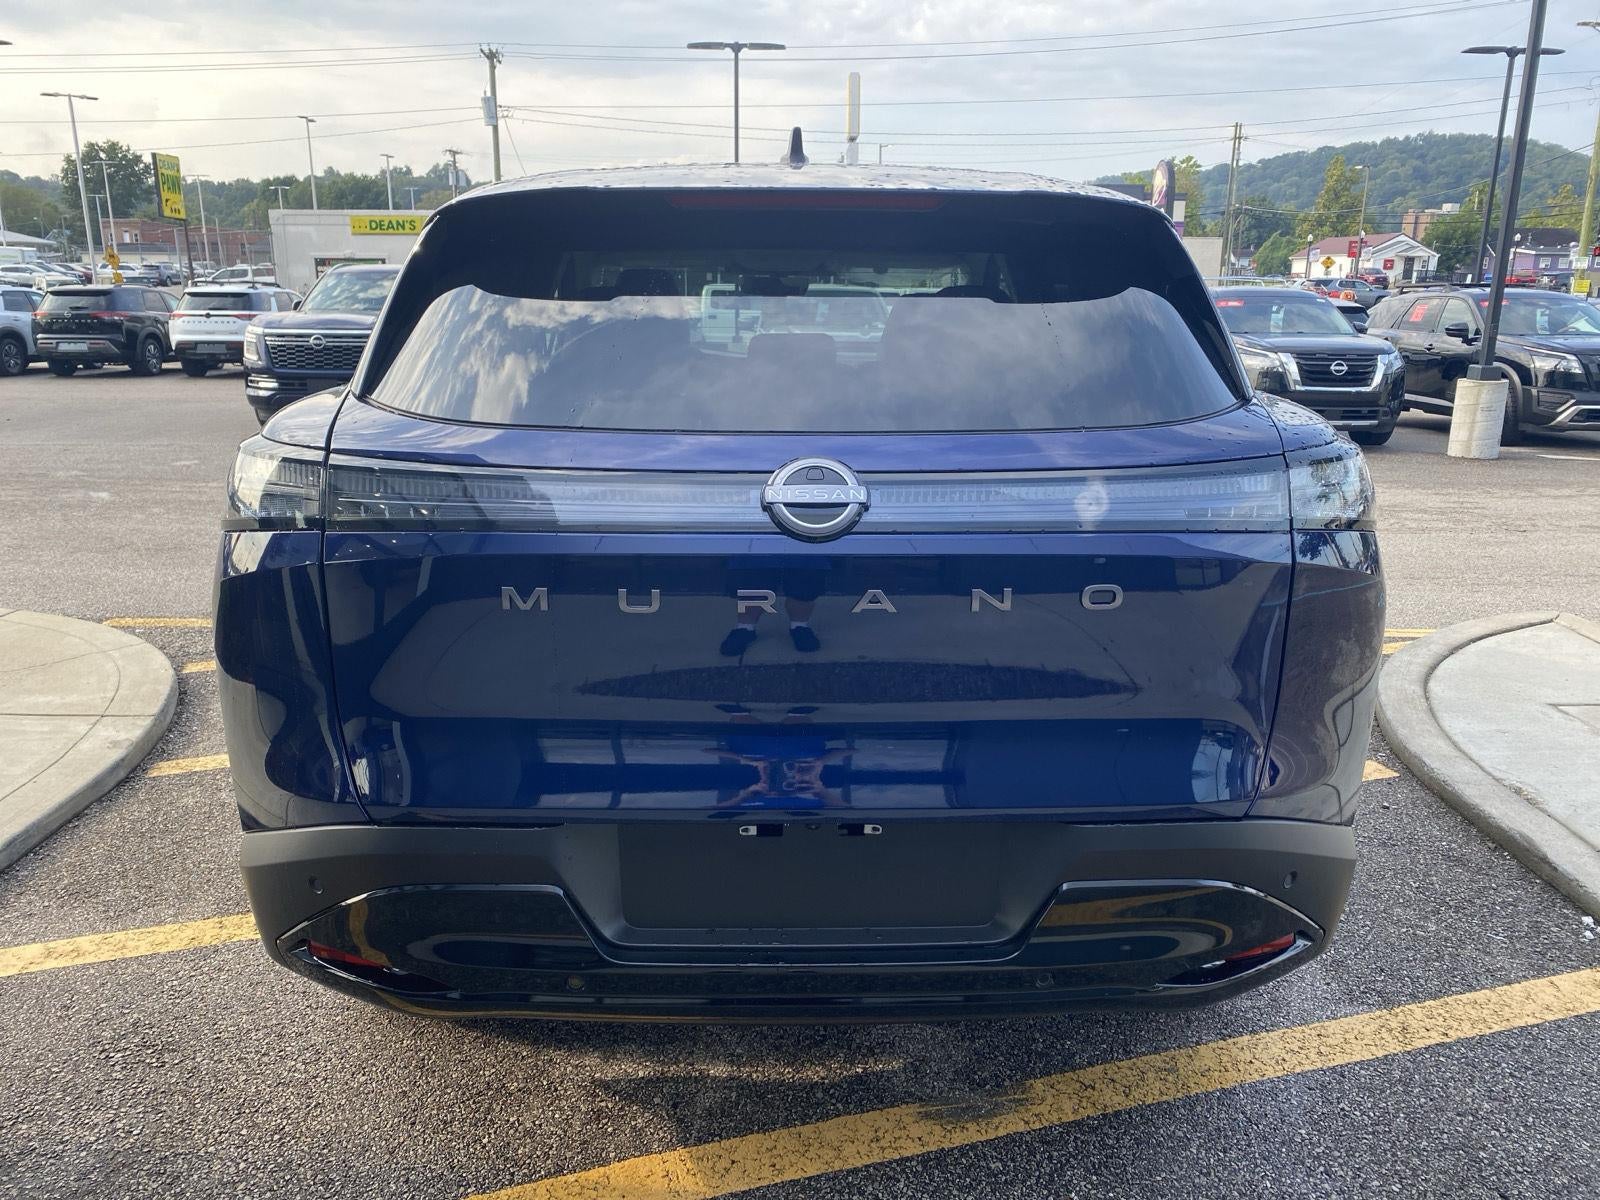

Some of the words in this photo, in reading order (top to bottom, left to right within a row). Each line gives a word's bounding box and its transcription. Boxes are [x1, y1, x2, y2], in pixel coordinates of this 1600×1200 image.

[160, 172, 181, 194] PAWN
[768, 488, 864, 500] NISSAN
[501, 584, 1123, 614] MURANO
